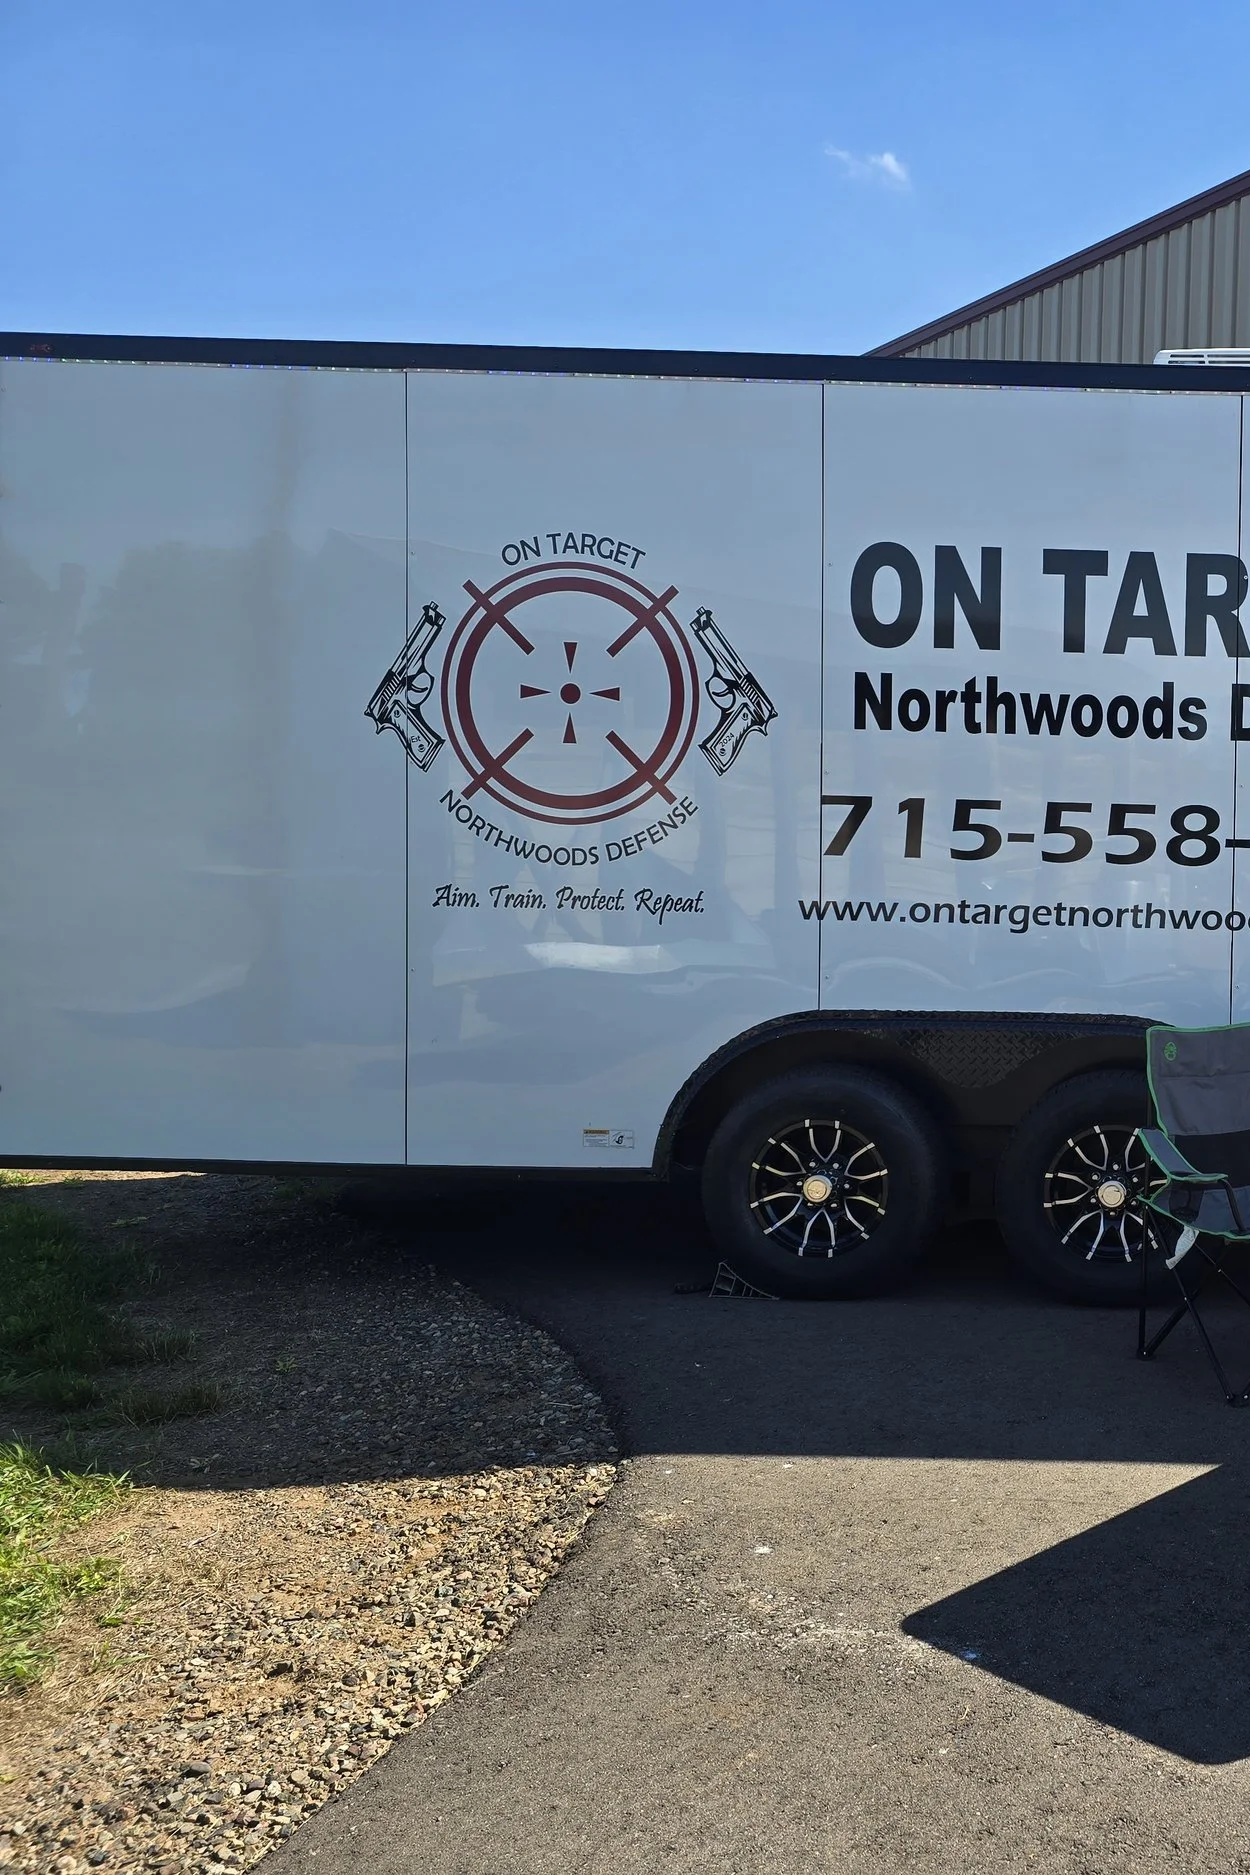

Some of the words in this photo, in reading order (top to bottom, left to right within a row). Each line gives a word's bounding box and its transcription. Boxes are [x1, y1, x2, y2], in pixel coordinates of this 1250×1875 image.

[502, 536, 541, 566] ON
[546, 532, 646, 569] TARGET
[850, 541, 1002, 651] ON
[854, 671, 1207, 741] Northwoods
[439, 789, 600, 866] NORTHWOODS
[606, 796, 699, 862] DEFENSE
[432, 884, 480, 908] Aim.
[489, 885, 547, 910] Train.
[555, 886, 625, 911] Protect.
[634, 888, 705, 925] Repeat.
